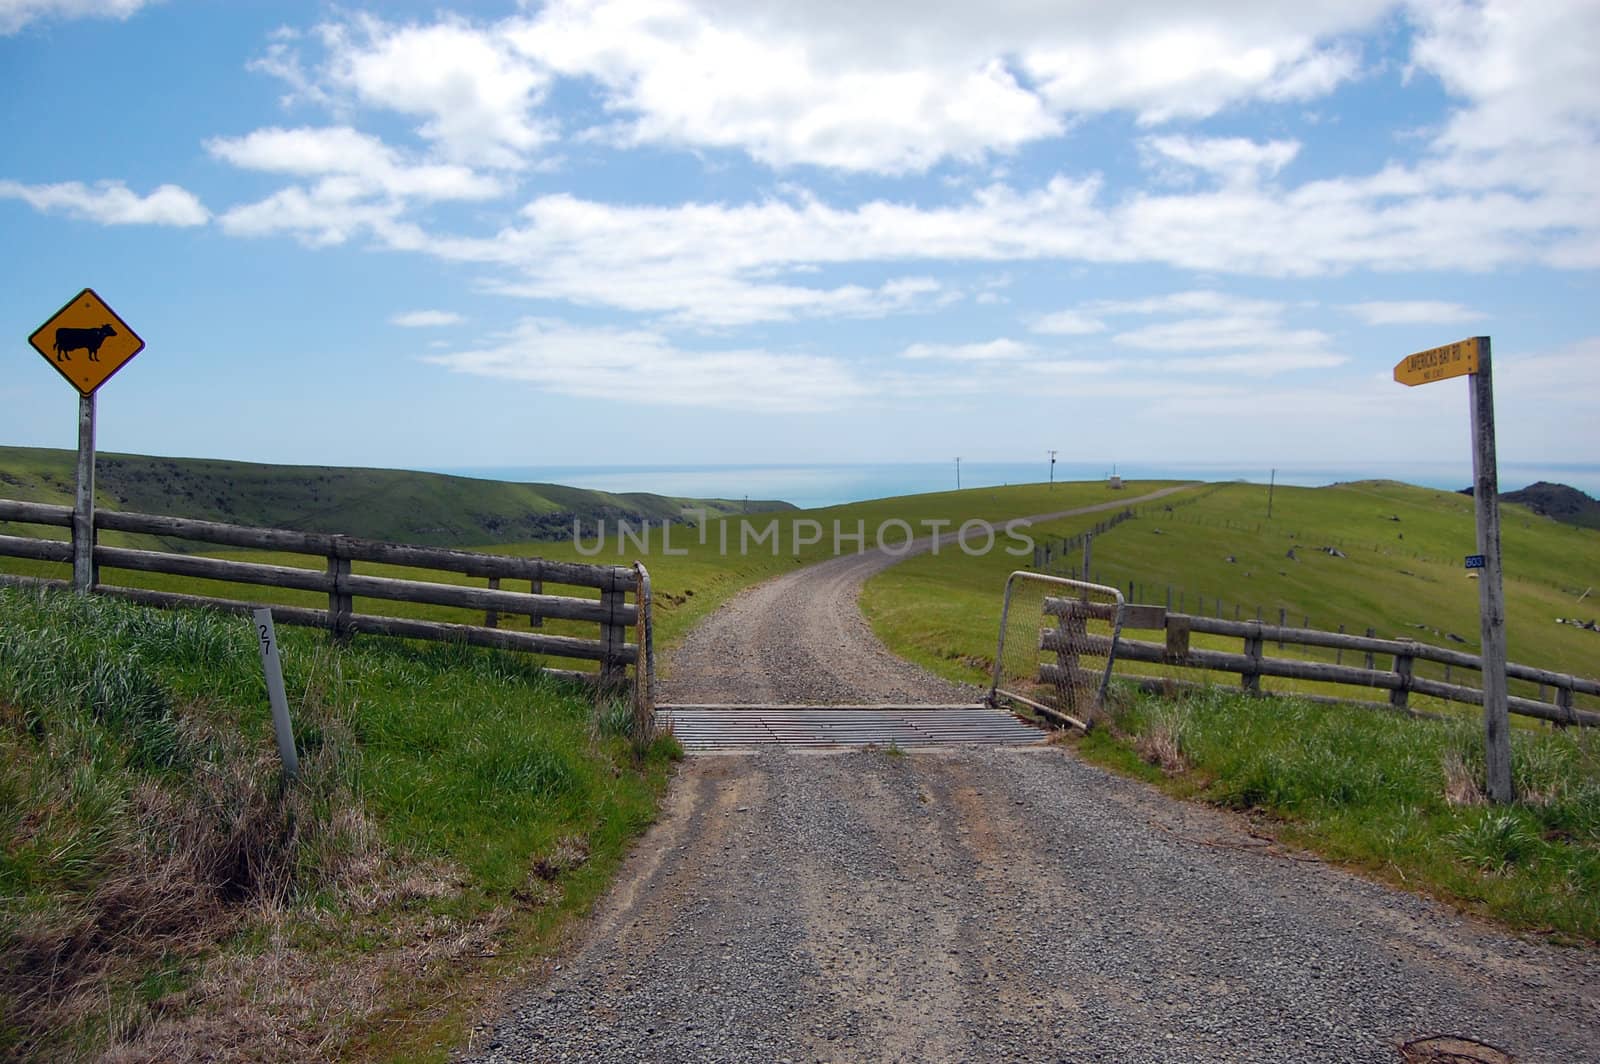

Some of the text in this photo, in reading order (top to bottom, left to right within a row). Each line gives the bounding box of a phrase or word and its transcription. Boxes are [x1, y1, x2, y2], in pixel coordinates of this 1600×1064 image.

[1439, 346, 1450, 365] BAY
[1452, 343, 1461, 361] RD
[1466, 557, 1481, 567] 603
